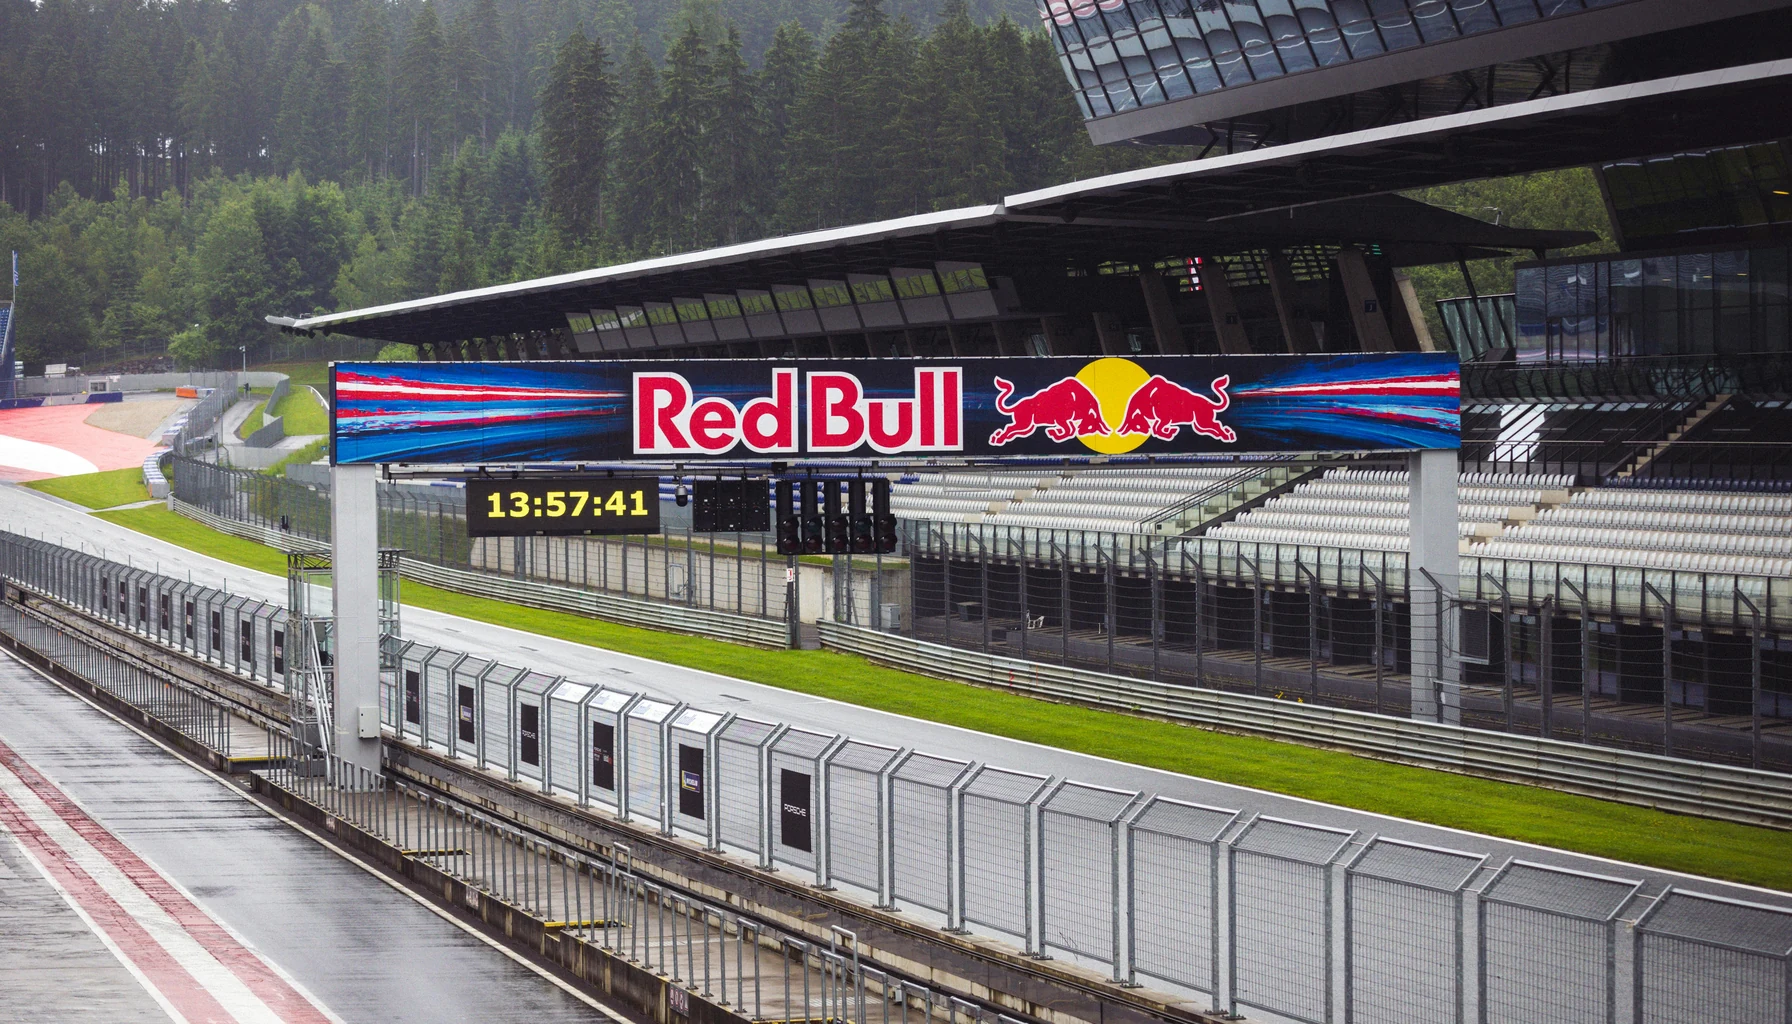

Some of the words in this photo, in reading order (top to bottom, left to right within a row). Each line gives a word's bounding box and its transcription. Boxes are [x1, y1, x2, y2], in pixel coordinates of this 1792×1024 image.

[634, 368, 797, 454] Red
[807, 367, 962, 454] Bull
[488, 490, 649, 518] 13:57:41
[784, 803, 807, 817] PORSCHE
